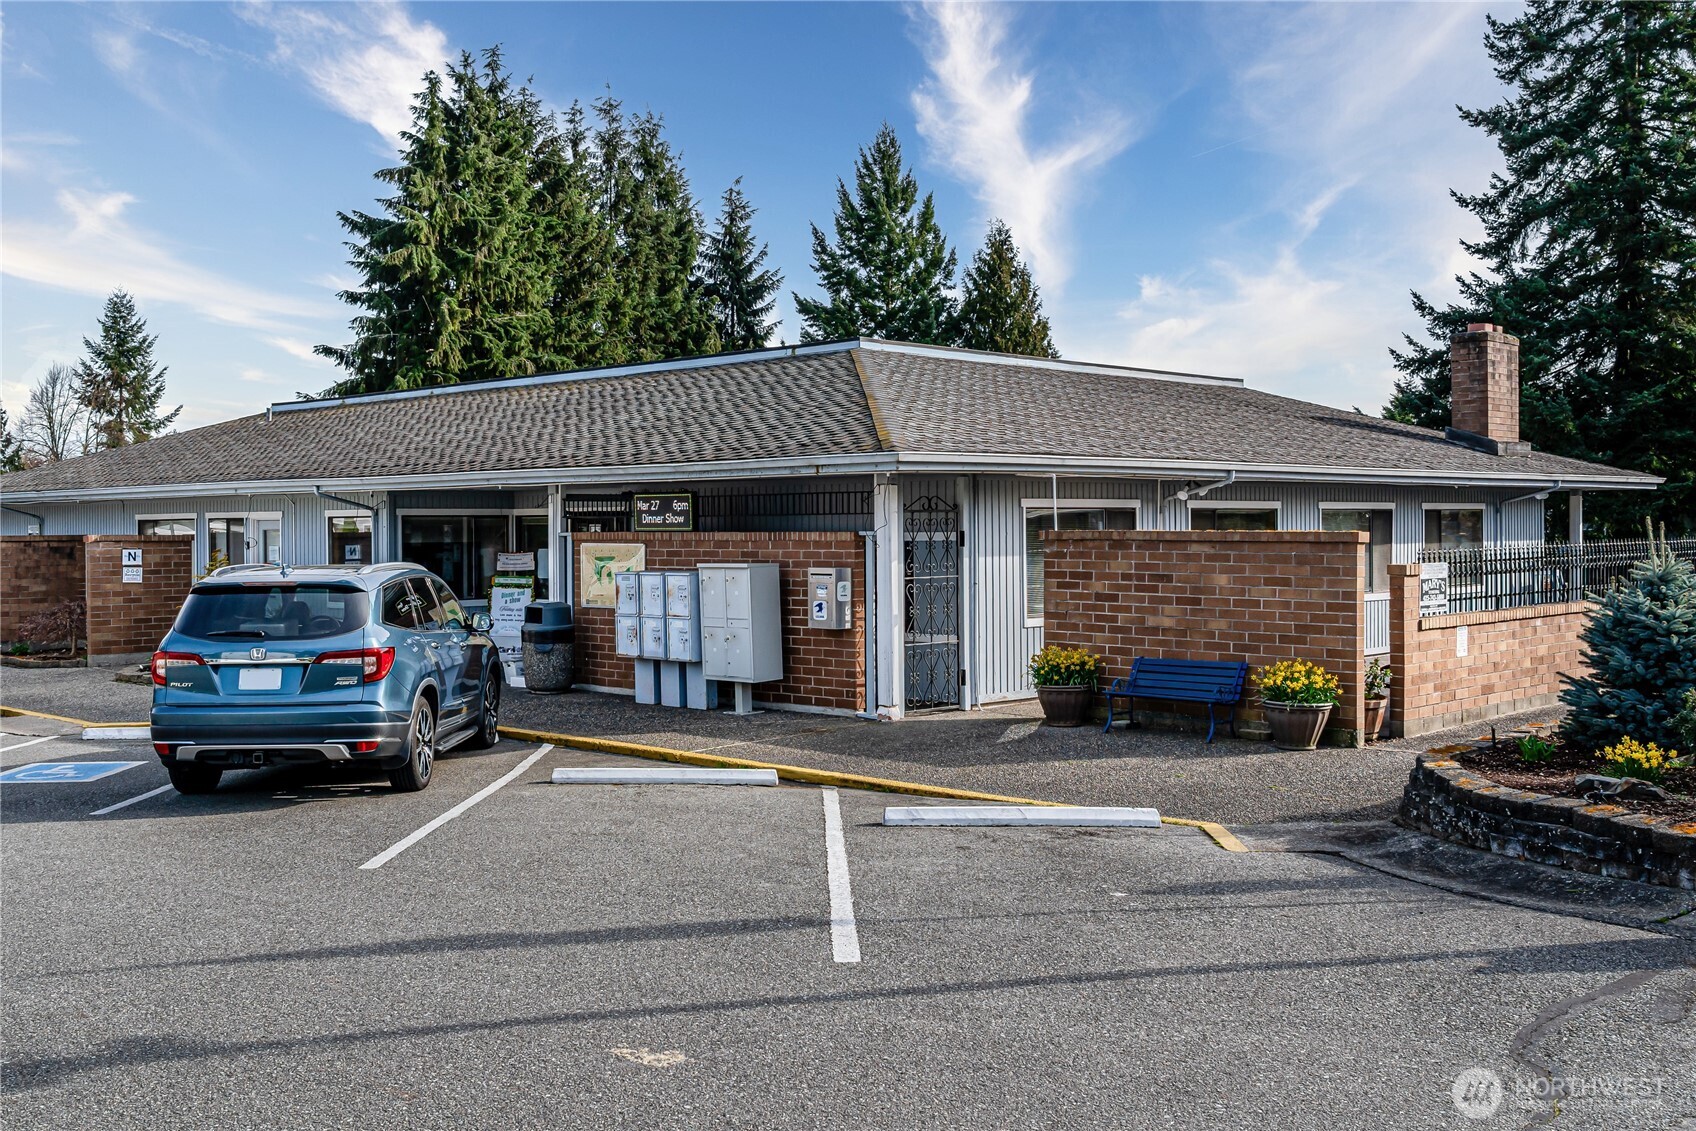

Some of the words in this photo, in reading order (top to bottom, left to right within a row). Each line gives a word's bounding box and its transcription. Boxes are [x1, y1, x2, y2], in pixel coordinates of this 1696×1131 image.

[637, 501, 649, 510] Mar
[650, 501, 660, 510] 27
[673, 500, 688, 511] 6pm
[642, 514, 664, 523] Dinner
[665, 513, 684, 523] Show
[128, 552, 136, 561] N
[1422, 579, 1445, 593] MARY'S
